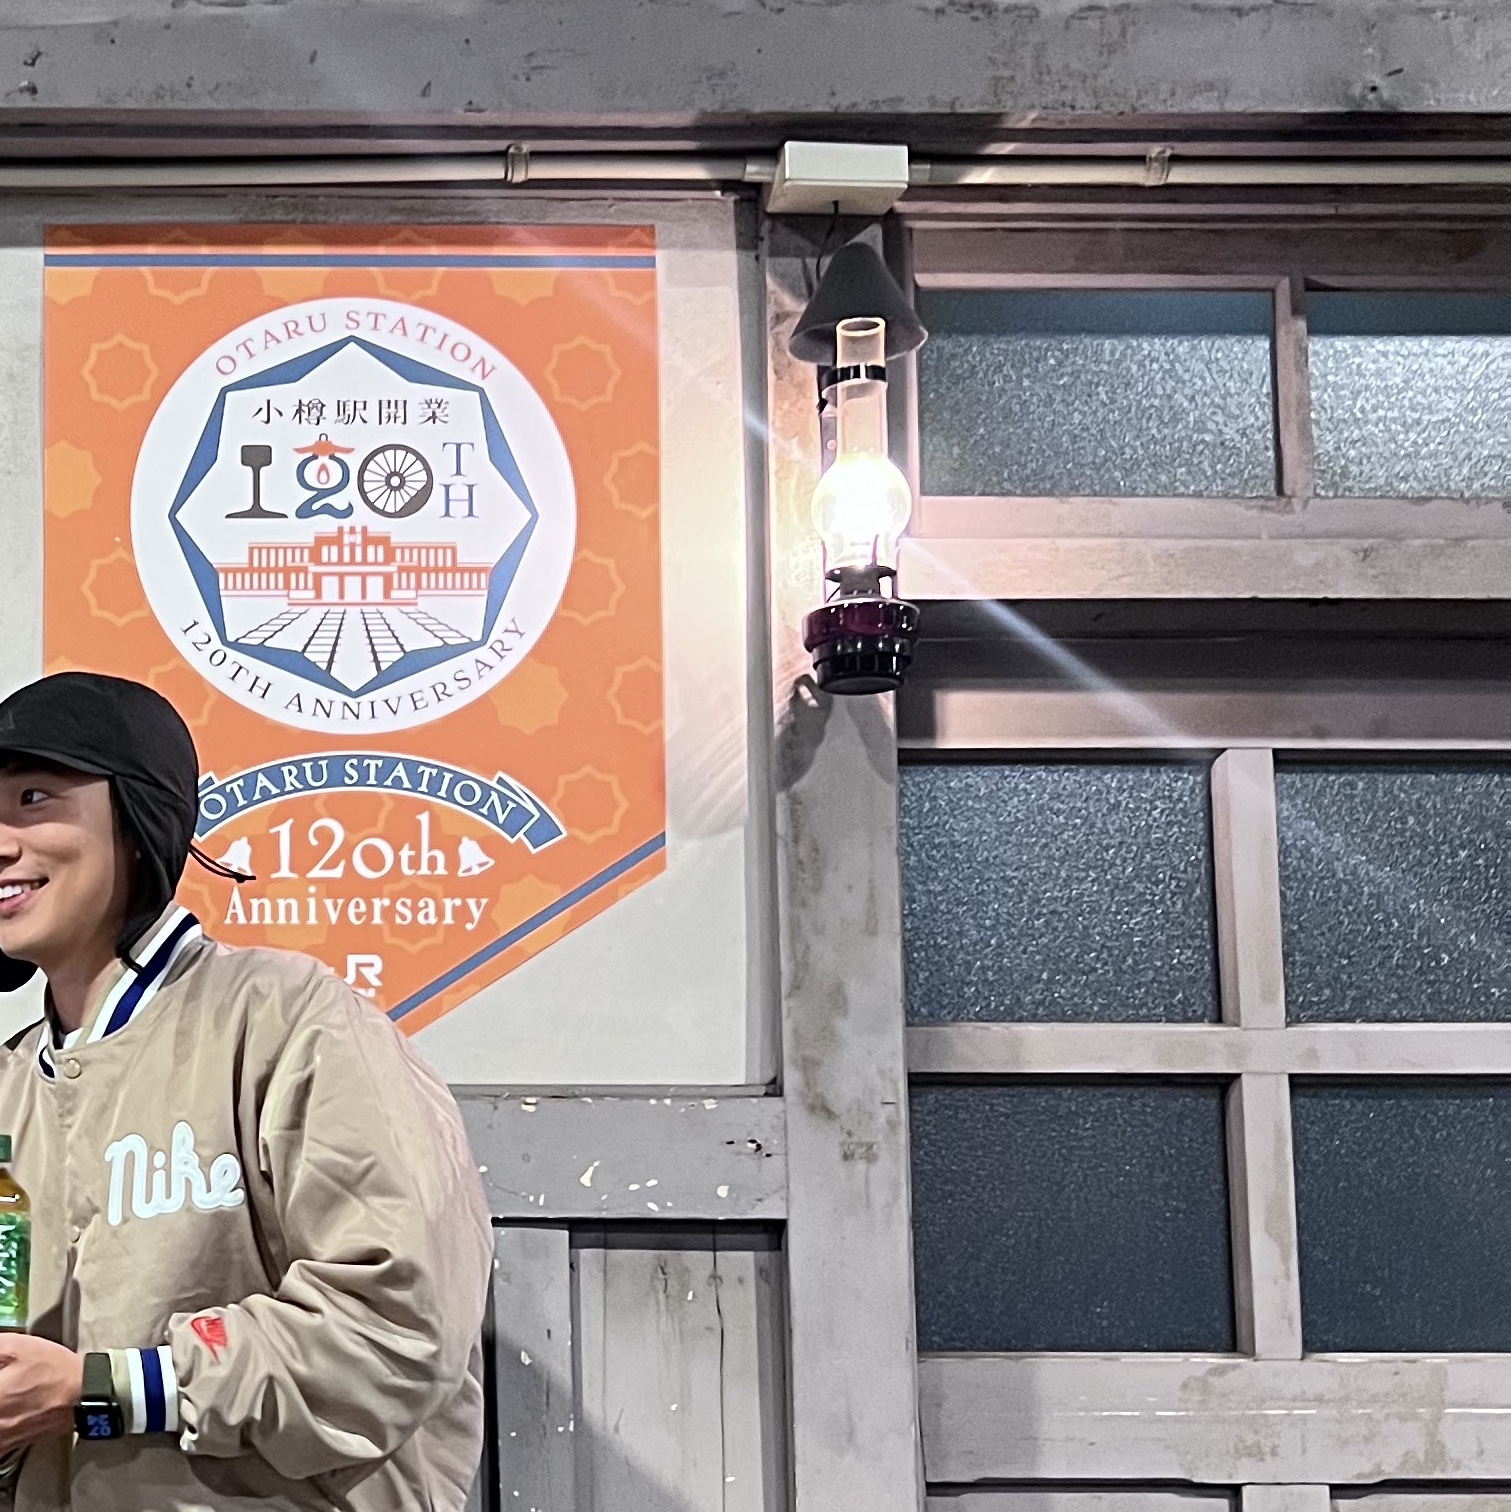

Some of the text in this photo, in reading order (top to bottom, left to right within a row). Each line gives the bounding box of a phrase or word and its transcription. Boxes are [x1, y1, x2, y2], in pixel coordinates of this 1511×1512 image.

[215, 310, 498, 381] OTARU STATION
[252, 398, 450, 426] 小樽駅開業
[180, 617, 527, 720] 120TH ANNIVERSARY
[199, 758, 517, 825] OTARU STATION
[268, 811, 448, 879] 120th
[223, 885, 490, 930] Anniversary
